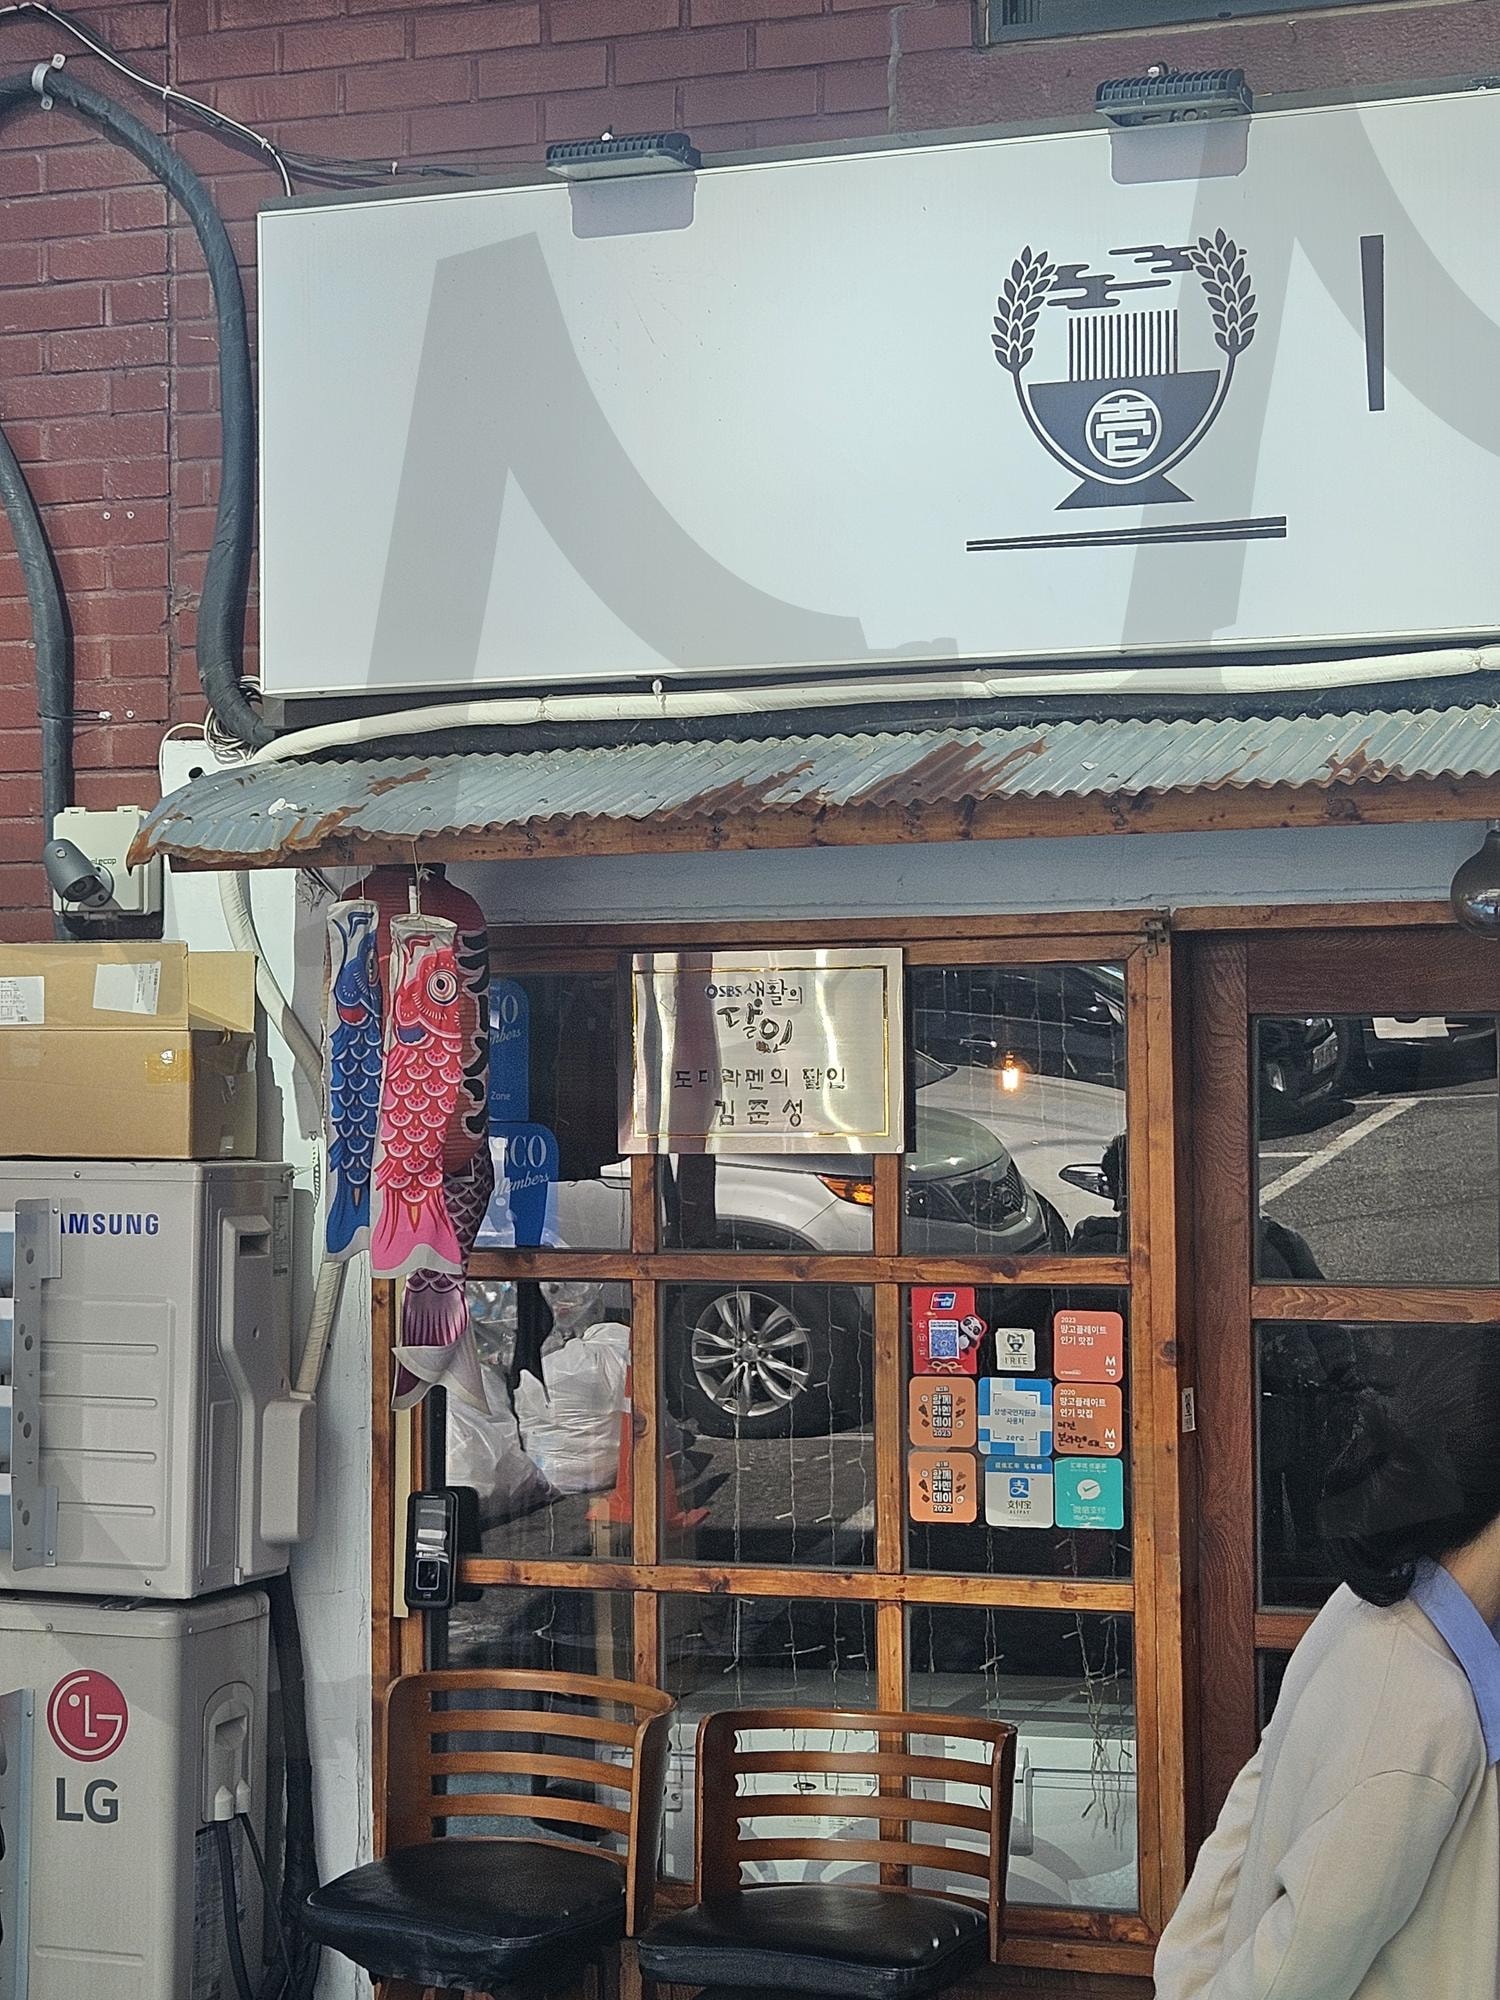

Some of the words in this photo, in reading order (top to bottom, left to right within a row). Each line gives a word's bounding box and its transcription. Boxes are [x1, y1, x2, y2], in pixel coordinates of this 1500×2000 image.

[744, 977, 803, 1007] 생활의
[716, 1001, 793, 1054] 달인
[60, 1213, 159, 1235] MSUNG
[1060, 1324, 1108, 1335] 망고플레이트
[1060, 1335, 1076, 1345] 인기
[1078, 1336, 1094, 1346] 맛집
[1004, 1356, 1028, 1365] IRIE
[1060, 1388, 1076, 1396] 2020
[1059, 1397, 1107, 1408] 망고플레이트
[1060, 1408, 1076, 1418] 인기
[1077, 1409, 1094, 1419] 맛집
[932, 1417, 952, 1428] 데이
[933, 1429, 952, 1437] 2023
[932, 1492, 952, 1503] 데이
[933, 1505, 953, 1513] 2022
[56, 1777, 119, 1824] LG
